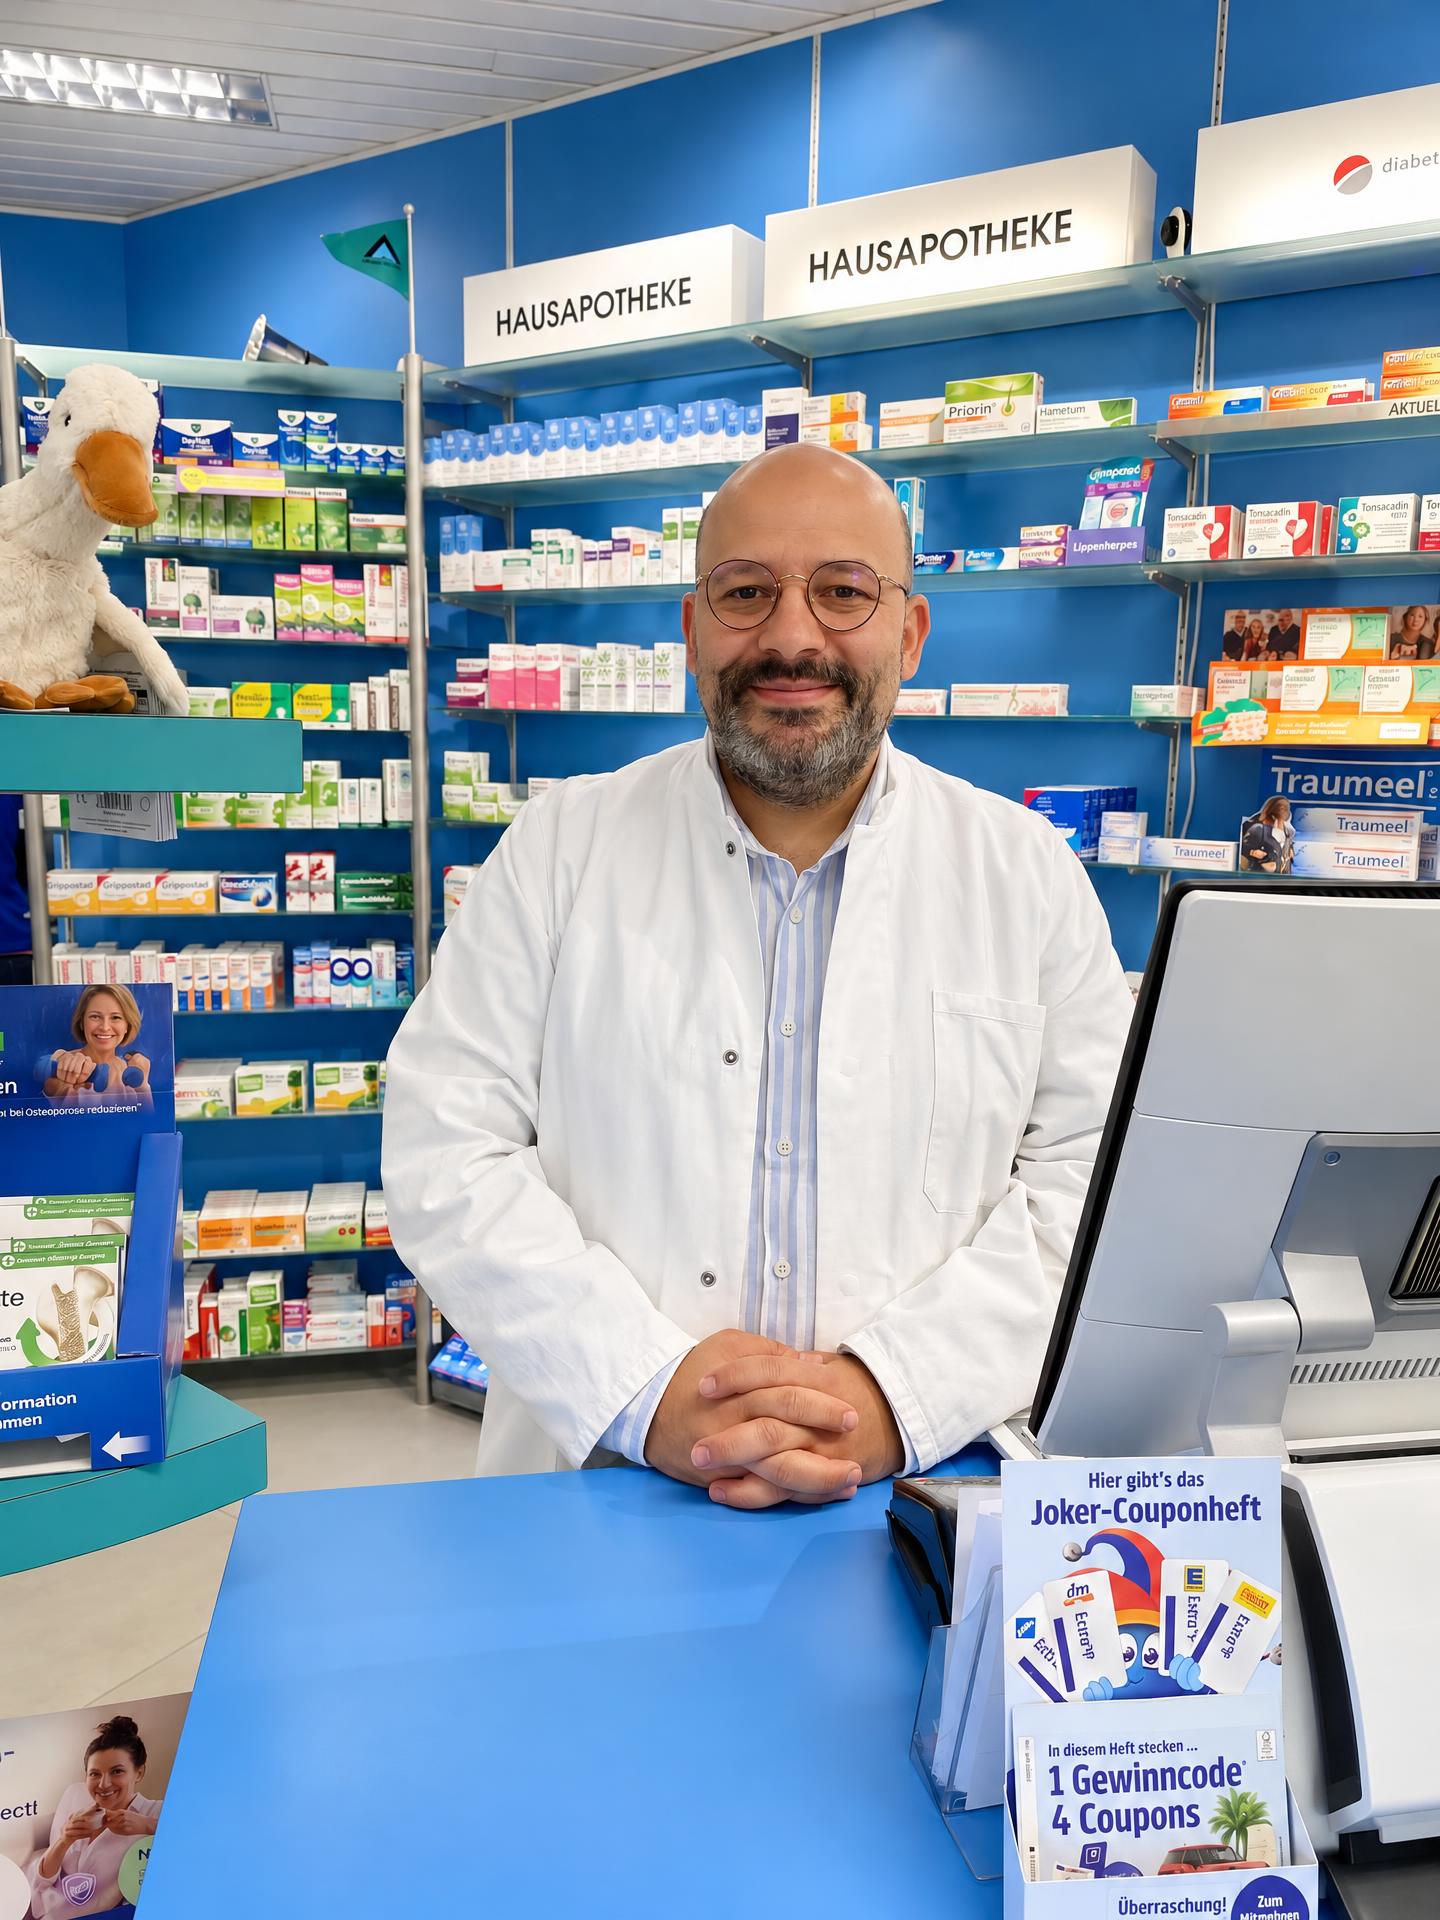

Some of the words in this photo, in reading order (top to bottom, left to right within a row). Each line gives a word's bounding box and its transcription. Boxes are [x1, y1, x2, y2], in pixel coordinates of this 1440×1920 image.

[809, 209, 1073, 283] HAUSAPOTHEKE
[496, 276, 692, 336] HAUSAPOTHEKE
[949, 403, 992, 419] Priorin
[1040, 405, 1086, 417] Hametum
[1249, 508, 1291, 518] Tonsacadin
[1361, 501, 1409, 512] Tonsacadin
[1073, 541, 1138, 554] Lippenherpes
[1271, 767, 1426, 799] Traumeel
[1337, 817, 1408, 833] Traumeel
[1174, 845, 1226, 859] Traumeel
[1334, 852, 1404, 868] Traumeel
[103, 880, 151, 891] Grippostad
[161, 880, 209, 891] Grippostad
[9, 1108, 24, 1117] bei
[25, 1106, 85, 1118] Osteoporose
[1089, 1472, 1122, 1489] Hier
[1127, 1471, 1172, 1492] gibt's
[1177, 1470, 1205, 1488] das
[1031, 1494, 1262, 1529] Joker-Couponheft
[1067, 1582, 1089, 1599] dm
[1049, 1744, 1060, 1757] In
[1064, 1743, 1106, 1757] diesem
[1110, 1741, 1135, 1755] Heft
[1138, 1740, 1184, 1754] stecken
[1049, 1765, 1064, 1796] 1
[1072, 1756, 1242, 1796] Gewinncode
[1052, 1804, 1071, 1836] 4
[1080, 1803, 1200, 1838] Coupons
[1118, 1896, 1226, 1915] Überraschung!
[1257, 1895, 1283, 1908] Zum
